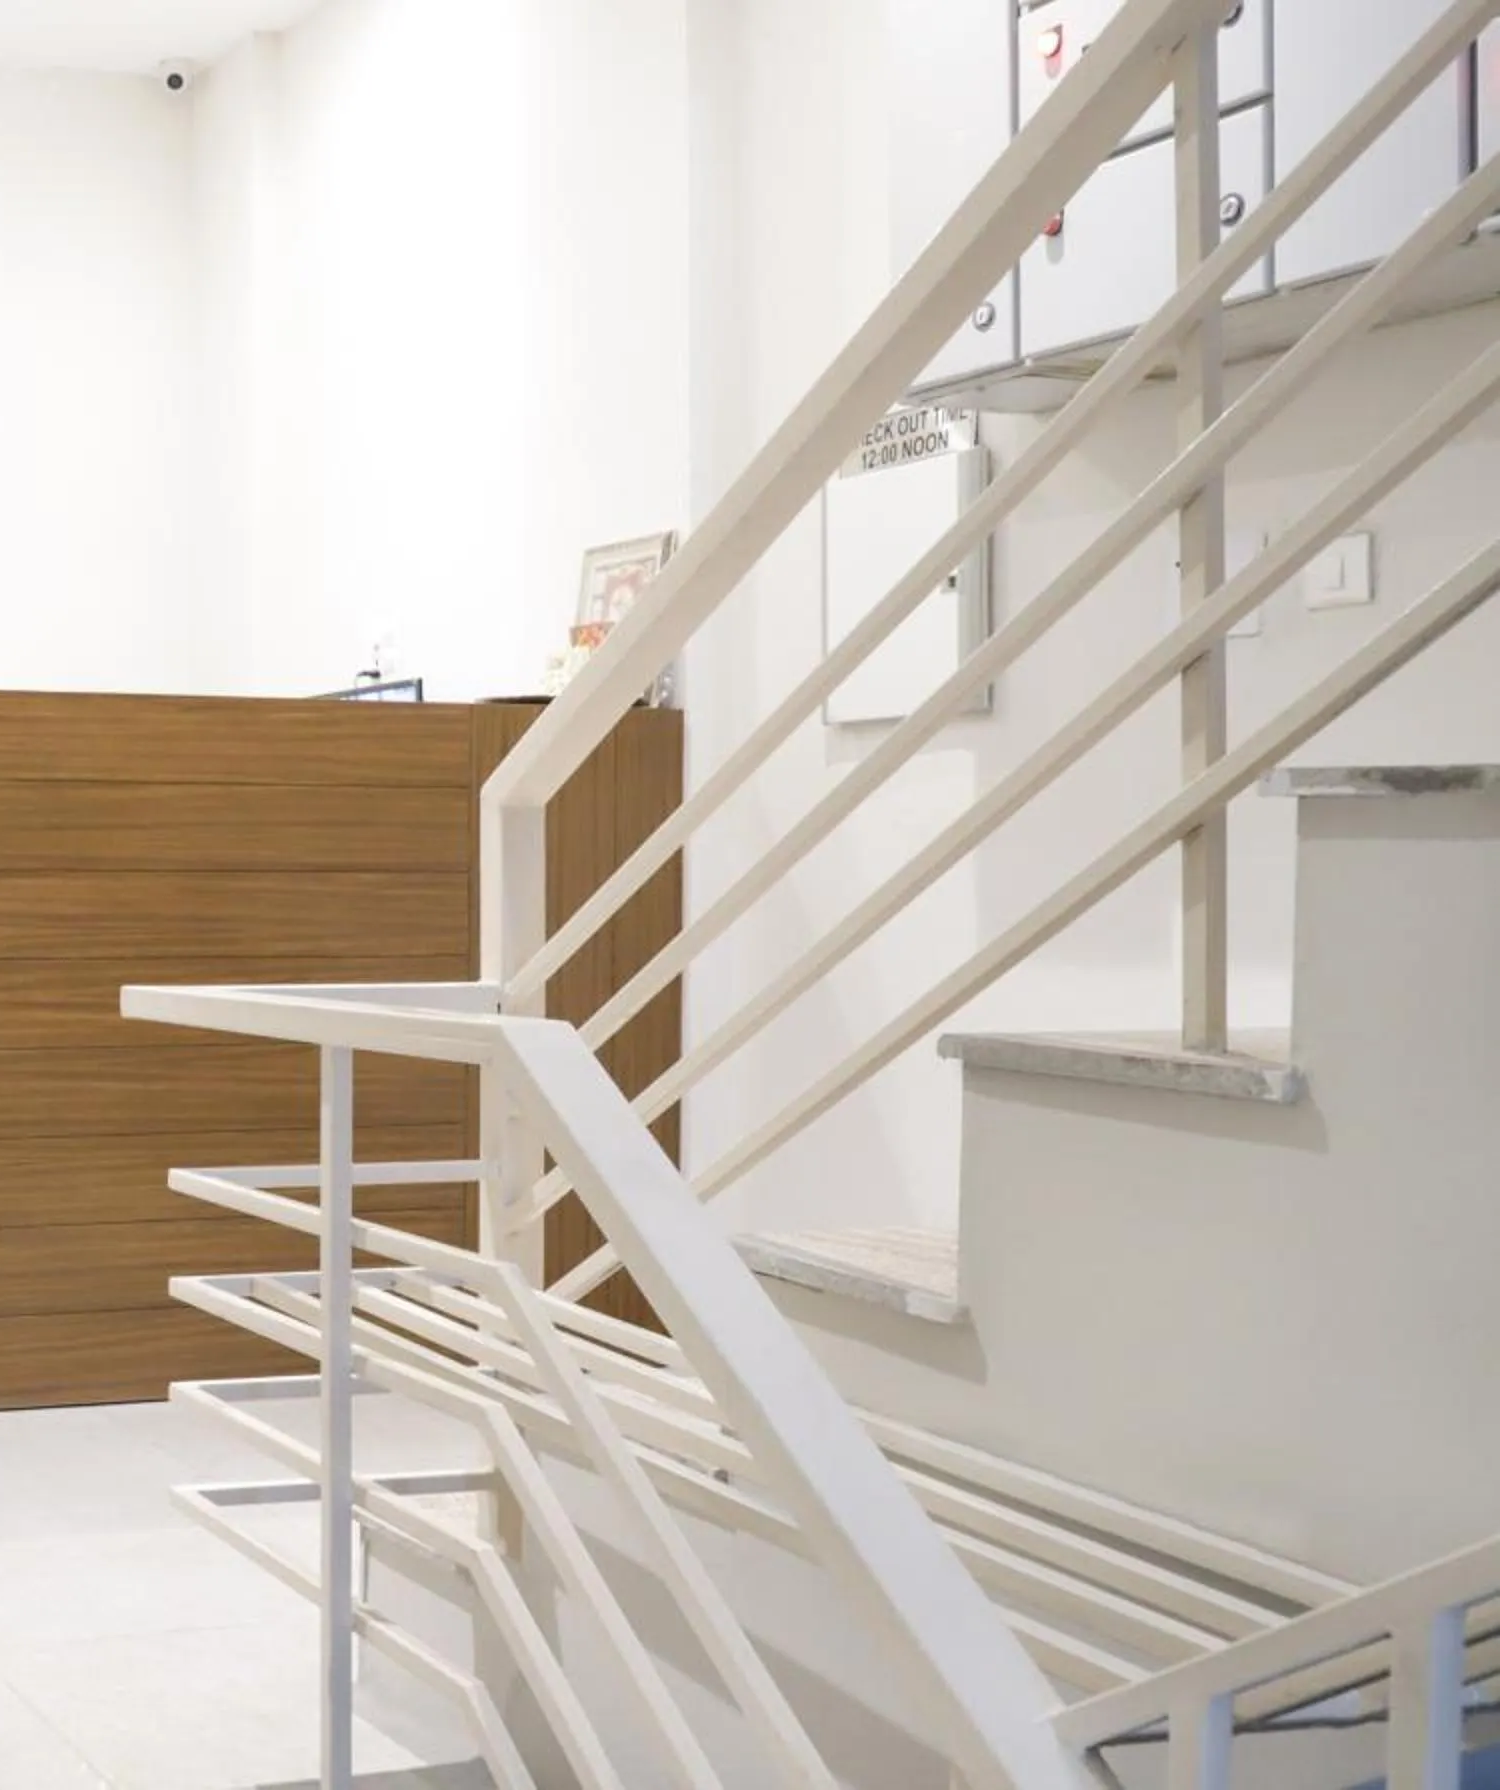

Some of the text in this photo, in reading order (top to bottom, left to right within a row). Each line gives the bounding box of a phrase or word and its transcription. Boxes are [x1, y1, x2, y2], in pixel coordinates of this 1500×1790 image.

[861, 419, 894, 447] ECK
[897, 409, 929, 436] OUT
[861, 430, 949, 470] 12:00 NOON
